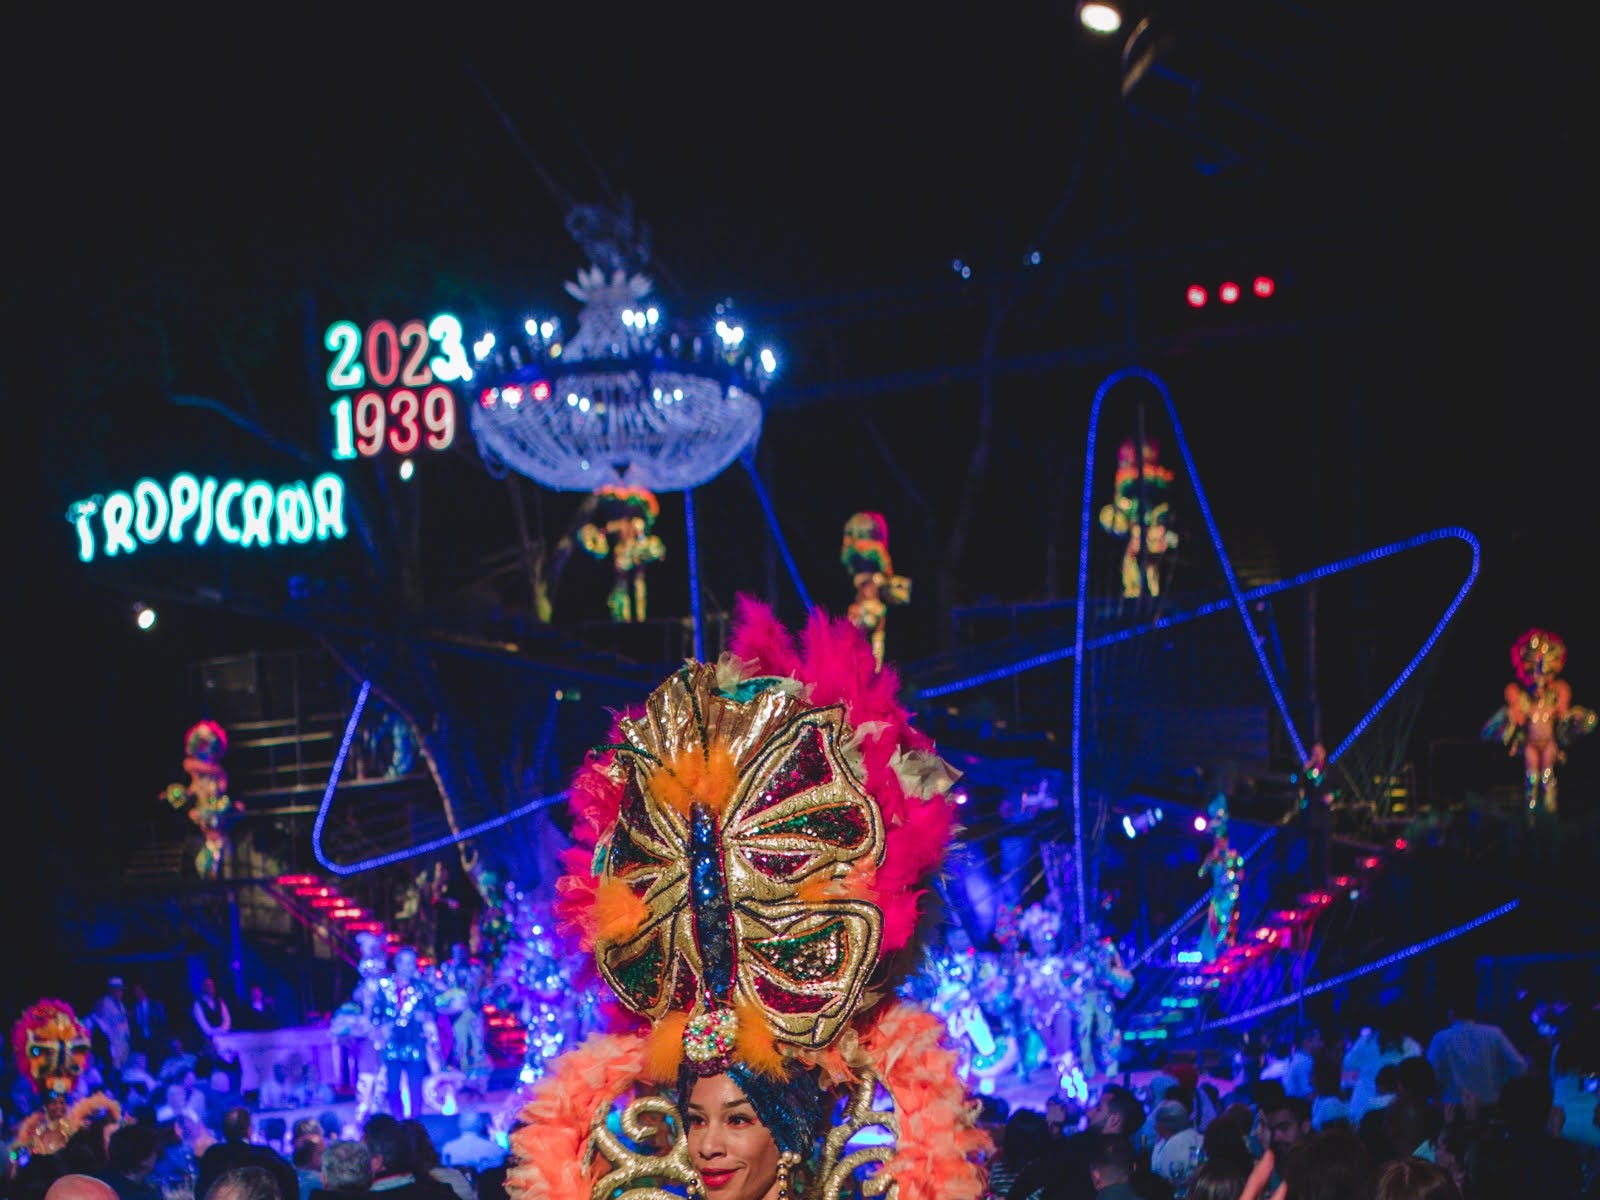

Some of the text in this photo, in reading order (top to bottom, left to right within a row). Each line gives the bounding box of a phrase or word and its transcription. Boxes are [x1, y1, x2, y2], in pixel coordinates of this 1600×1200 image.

[325, 313, 473, 390] 2023
[330, 385, 456, 459] 1939
[66, 472, 348, 562] TROPICANA
